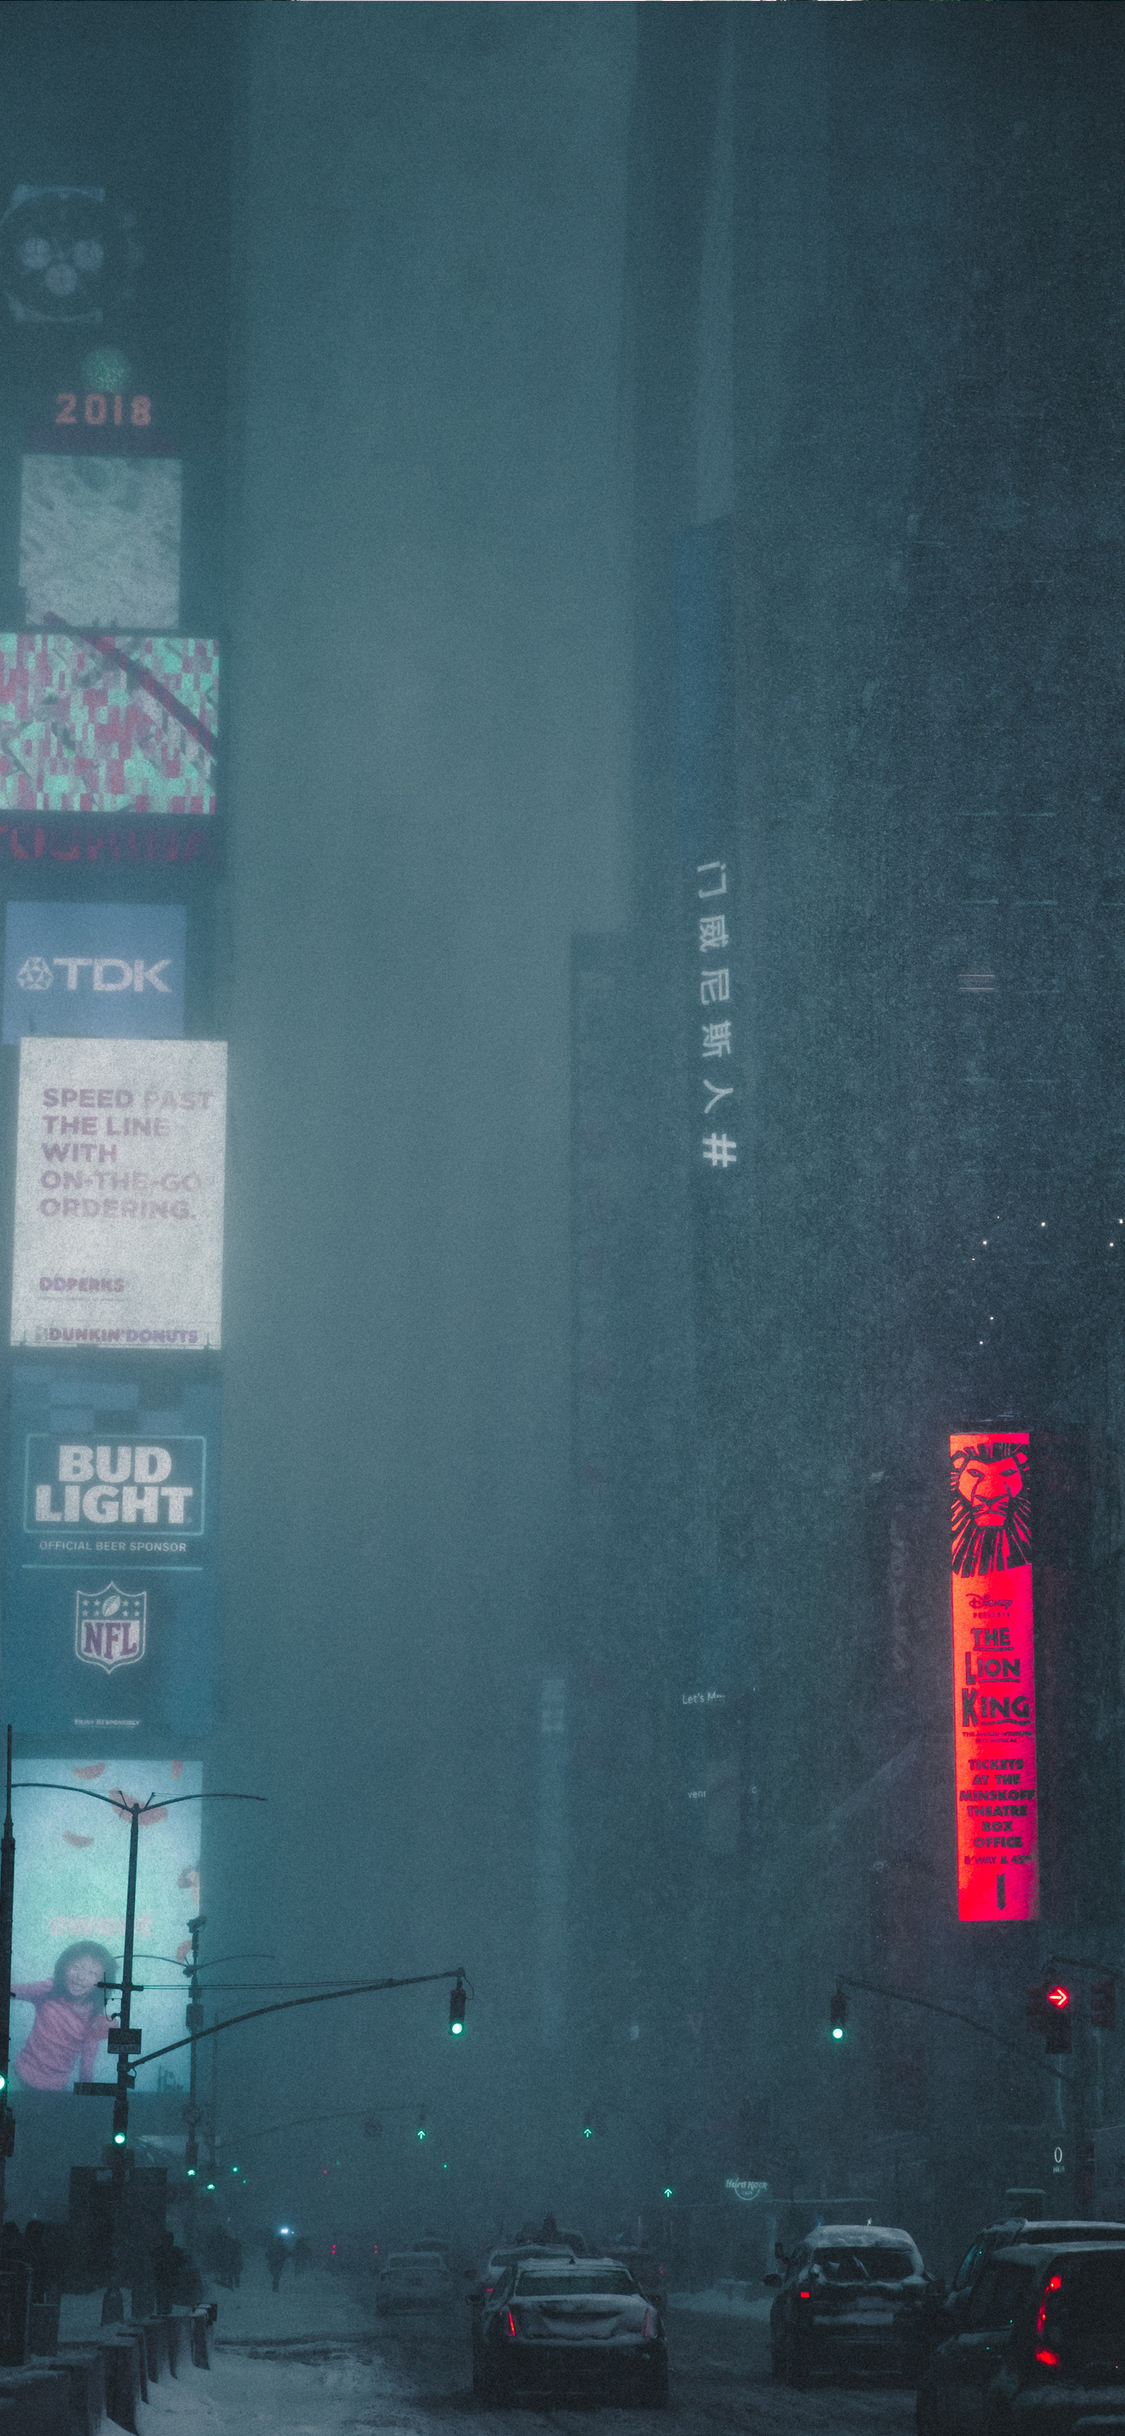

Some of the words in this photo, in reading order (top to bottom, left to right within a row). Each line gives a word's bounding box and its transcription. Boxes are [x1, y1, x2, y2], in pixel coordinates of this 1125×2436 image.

[55, 393, 153, 426] 2018
[53, 957, 173, 994] TDK
[43, 1088, 134, 1110] SPEED
[143, 1090, 215, 1111] PAST
[43, 1115, 97, 1136] THE
[106, 1117, 171, 1137] LINE
[41, 1143, 118, 1163] WITH
[40, 1170, 202, 1192] ON-THE-GO
[40, 1198, 197, 1220] ORDERING.
[58, 1444, 172, 1485] BUD
[35, 1485, 193, 1525] LIGHT
[39, 1540, 92, 1552] OFFICIAL
[96, 1541, 126, 1552] BEER
[130, 1541, 187, 1553] SPONSOR
[84, 1622, 138, 1660] NFL
[971, 1628, 1010, 1646] THE
[965, 1651, 1021, 1685] LION
[682, 1692, 705, 1705] Let's
[962, 1688, 1030, 1727] KING
[968, 1758, 1025, 1770] TICKETS
[972, 1774, 989, 1785] AT
[995, 1774, 1021, 1785] THE
[959, 1789, 1036, 1802] MINSKOFF
[967, 1805, 1028, 1817] THEATRE
[982, 1821, 1013, 1832] BOX
[974, 1836, 1023, 1848] OFFICE
